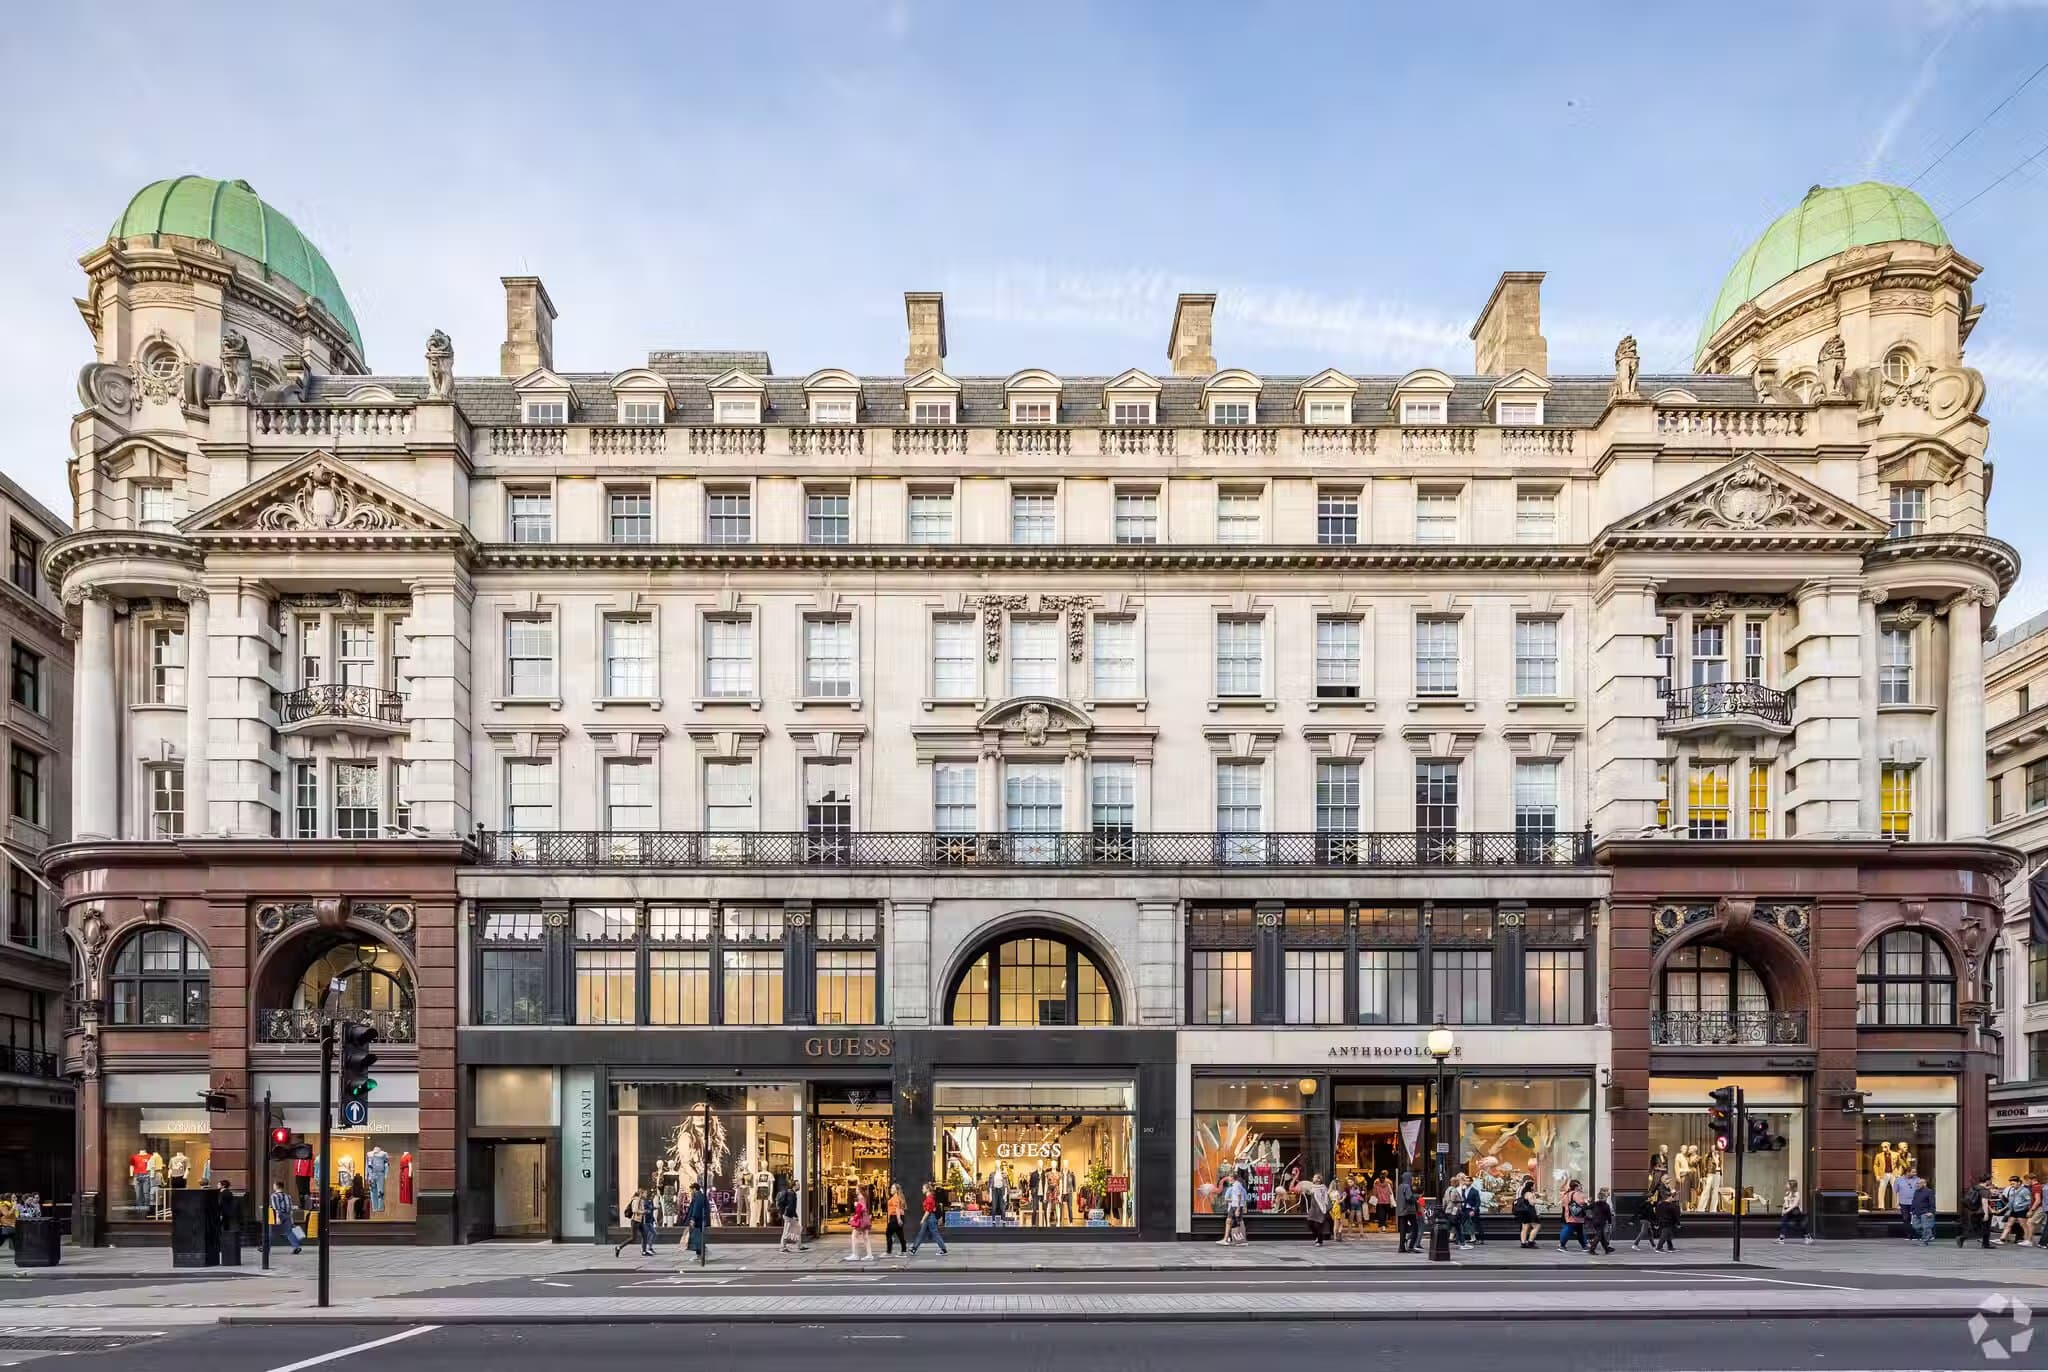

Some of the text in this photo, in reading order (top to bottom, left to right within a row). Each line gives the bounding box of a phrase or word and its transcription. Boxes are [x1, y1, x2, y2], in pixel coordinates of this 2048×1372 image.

[805, 1037, 891, 1057] GUESS
[1328, 1046, 1461, 1057] ANTHROPOLOE
[367, 1119, 390, 1132] Klein
[581, 1089, 592, 1163] LINEN HALL
[996, 1143, 1061, 1158] GUESS
[1248, 1175, 1269, 1185] SALE
[1261, 1192, 1276, 1201] OFF
